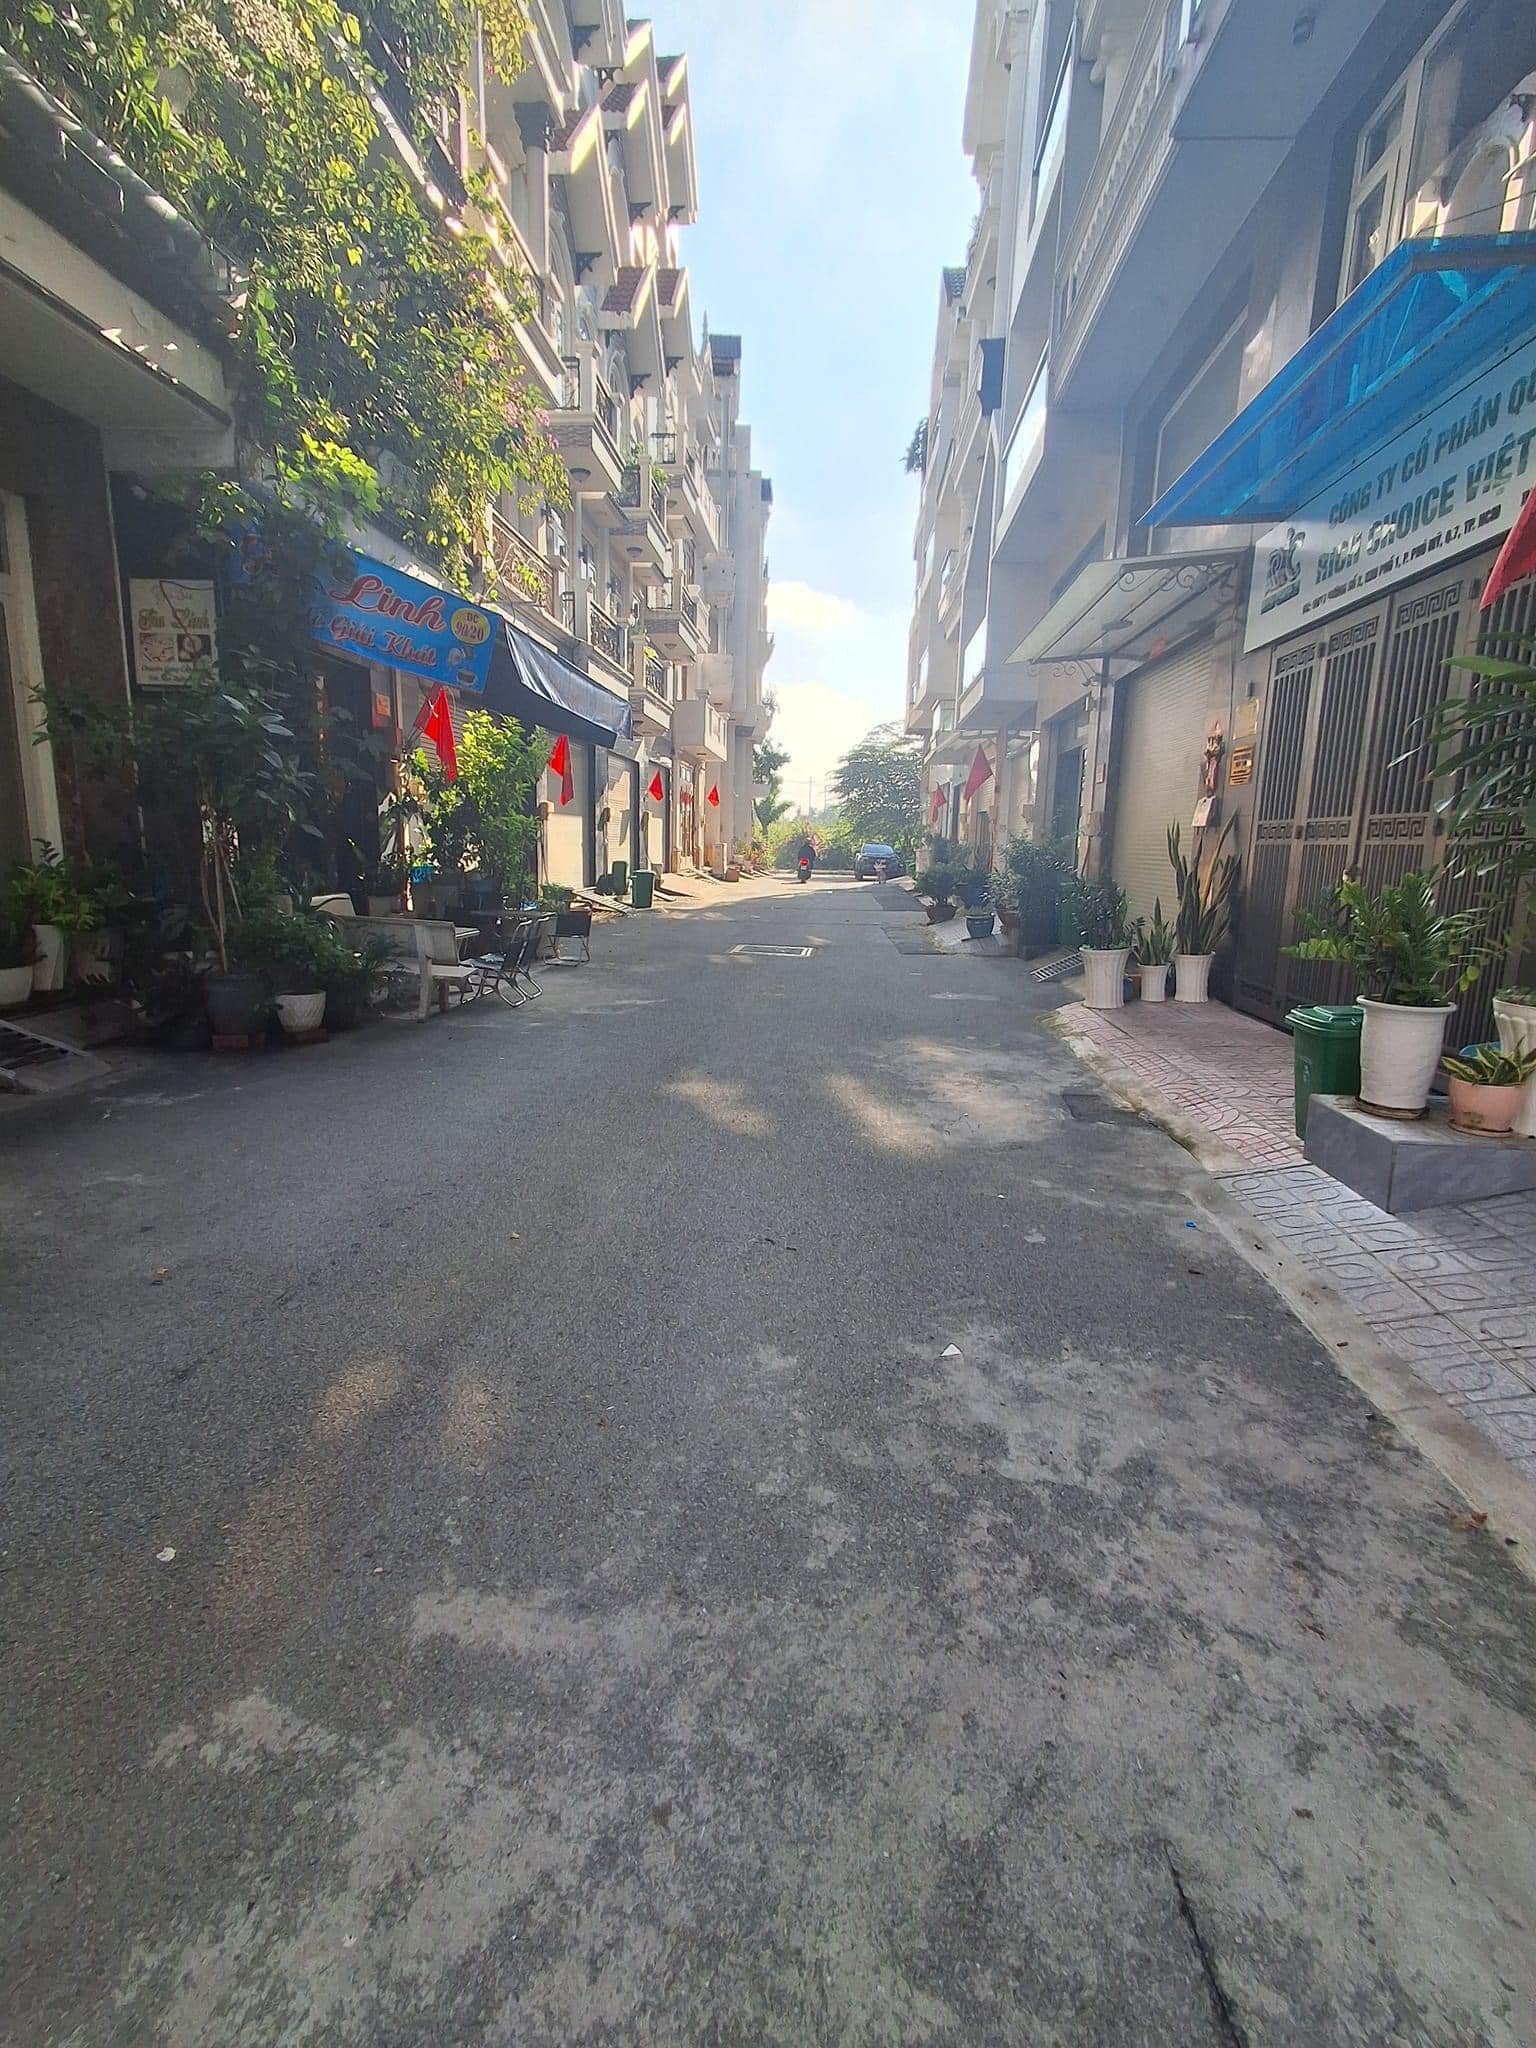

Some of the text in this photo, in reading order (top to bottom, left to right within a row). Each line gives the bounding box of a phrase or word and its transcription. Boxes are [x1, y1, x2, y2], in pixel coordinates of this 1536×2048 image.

[1328, 481, 1372, 529] CÔNG
[1376, 463, 1398, 500] TY
[1367, 474, 1458, 556] CHOICE
[1466, 428, 1536, 503] VIỆT
[329, 573, 447, 633] Linh
